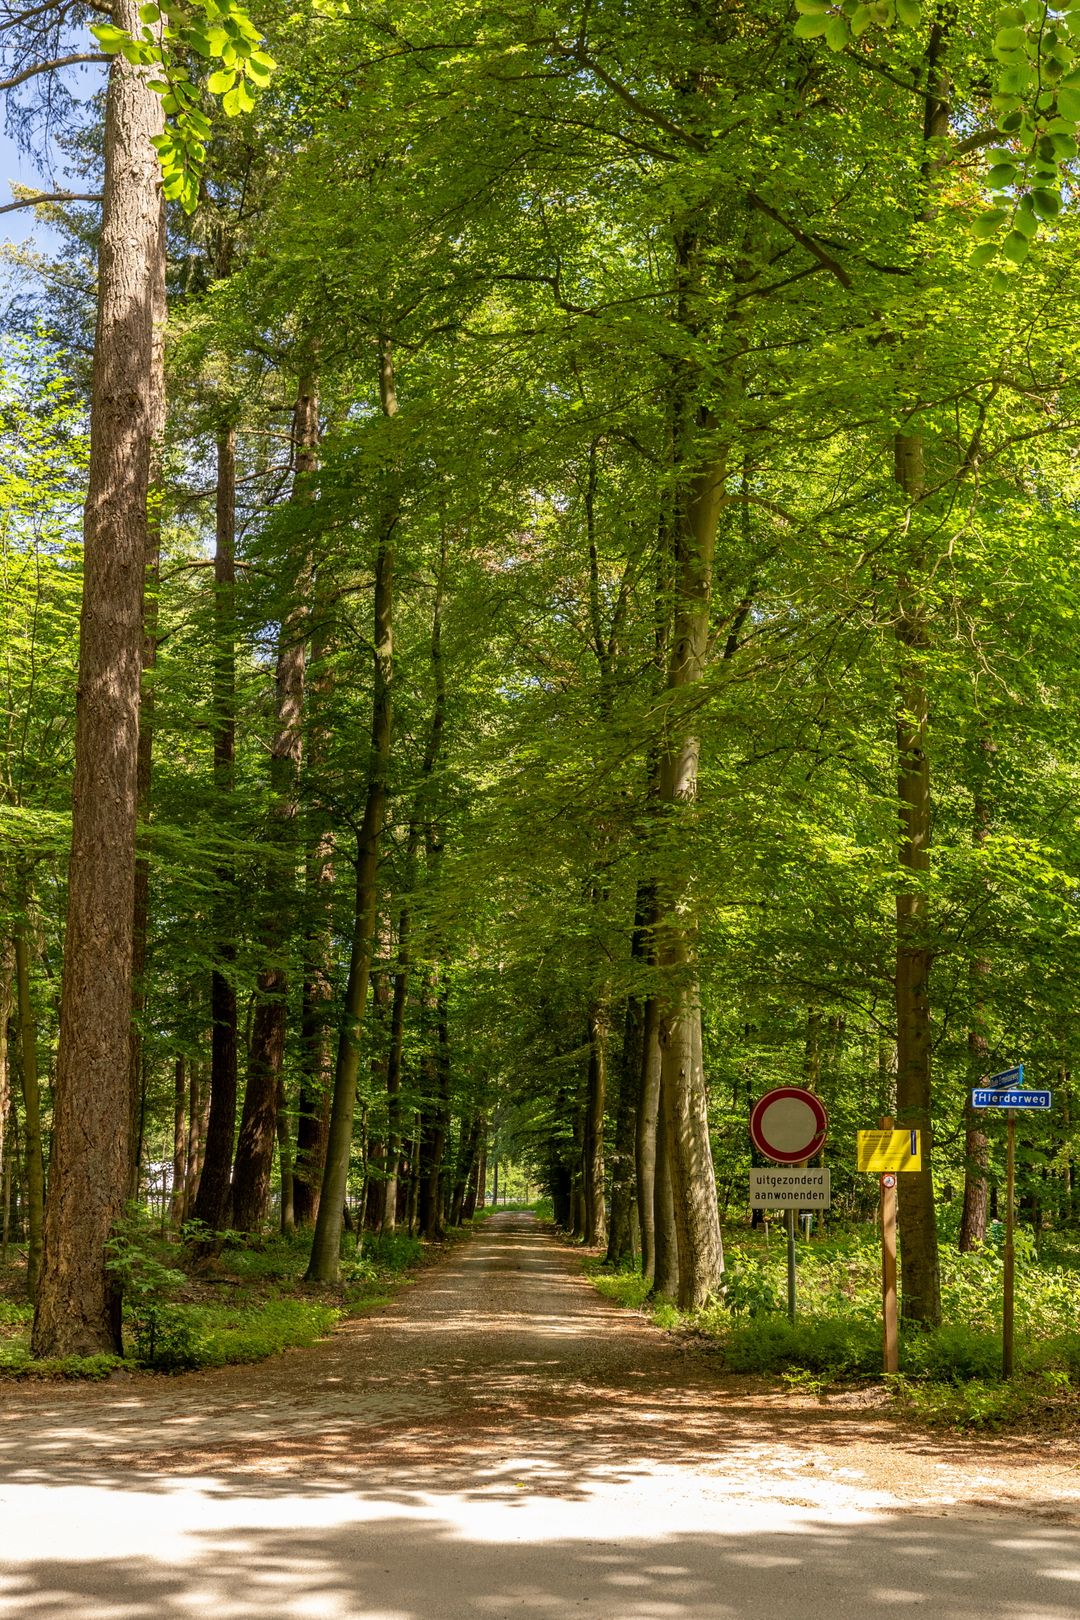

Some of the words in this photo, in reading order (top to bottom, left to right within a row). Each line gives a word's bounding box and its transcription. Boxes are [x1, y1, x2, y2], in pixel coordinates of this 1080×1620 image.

[978, 1093, 1046, 1106] Hierderweg
[756, 1175, 823, 1188] uitgezonderd
[755, 1190, 825, 1200] aanwonenden
